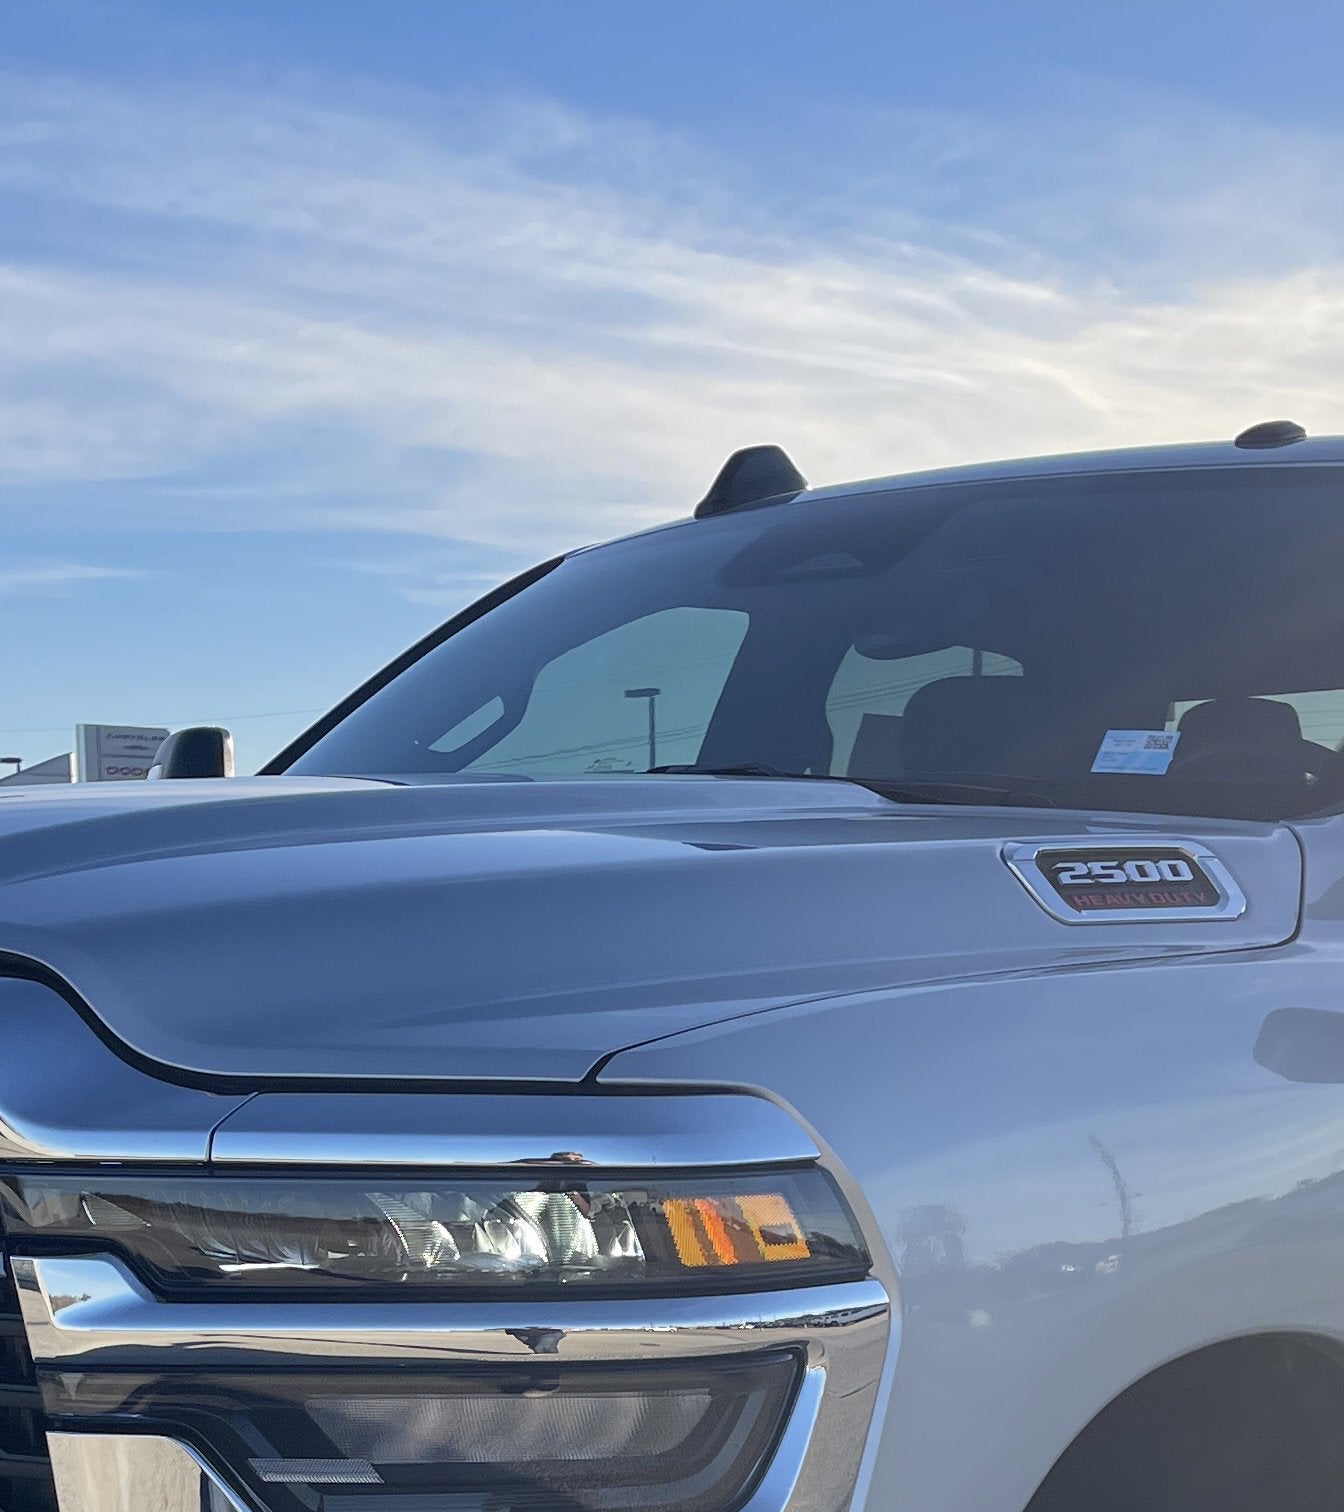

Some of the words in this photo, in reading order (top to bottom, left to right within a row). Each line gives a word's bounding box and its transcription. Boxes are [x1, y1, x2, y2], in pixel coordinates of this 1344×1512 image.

[1051, 859, 1194, 886] 2500
[1072, 893, 1145, 908] HEAVY
[1147, 890, 1207, 906] DUTY
